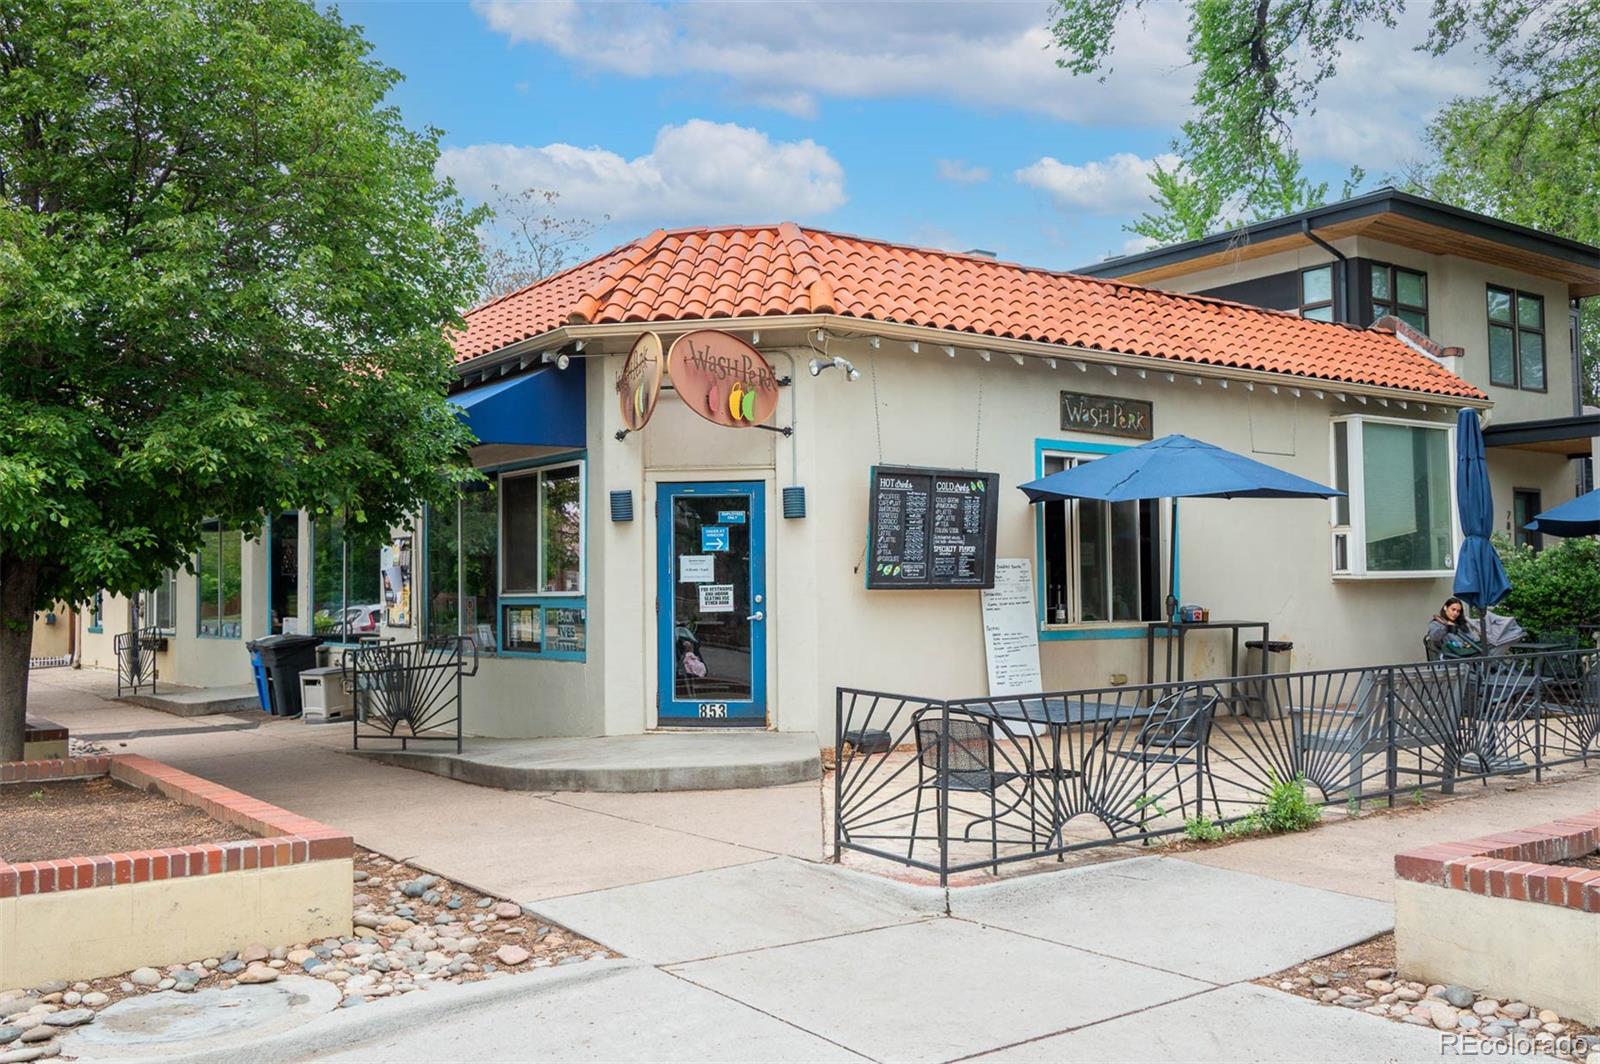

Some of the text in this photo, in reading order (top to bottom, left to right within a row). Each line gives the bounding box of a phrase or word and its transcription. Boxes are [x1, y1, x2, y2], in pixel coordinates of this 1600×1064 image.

[880, 478, 895, 487] HOT
[936, 482, 954, 490] COLD
[700, 704, 726, 718] 853
